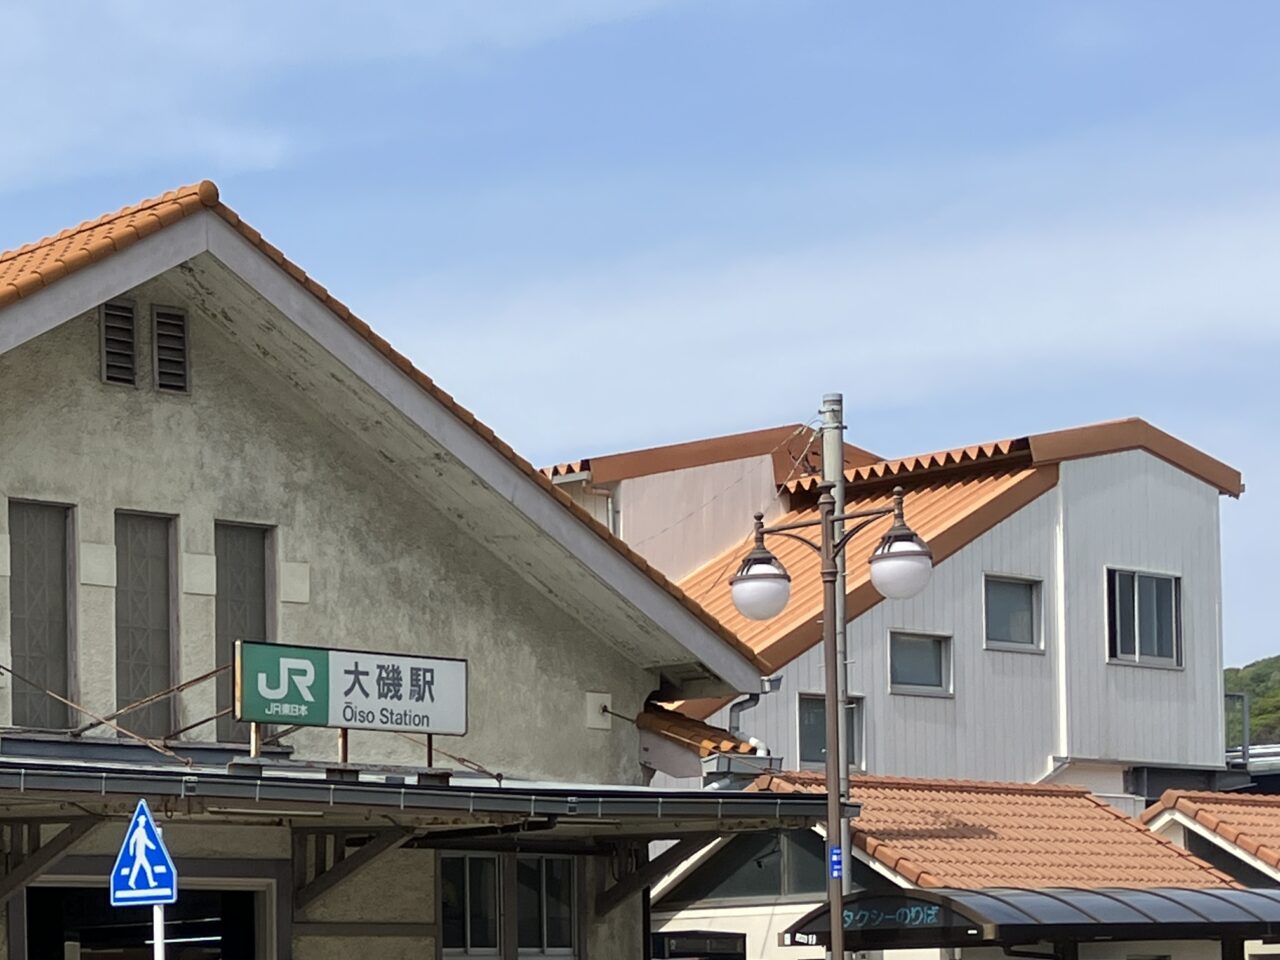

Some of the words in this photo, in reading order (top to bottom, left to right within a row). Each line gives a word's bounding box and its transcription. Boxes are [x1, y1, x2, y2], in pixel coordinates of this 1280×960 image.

[257, 657, 315, 702] JR
[343, 661, 435, 703] 大磯駅
[264, 703, 308, 716] JR東日本
[342, 702, 375, 724] Ōiso
[379, 707, 430, 727] Station
[843, 906, 939, 928] タクシーのりば
